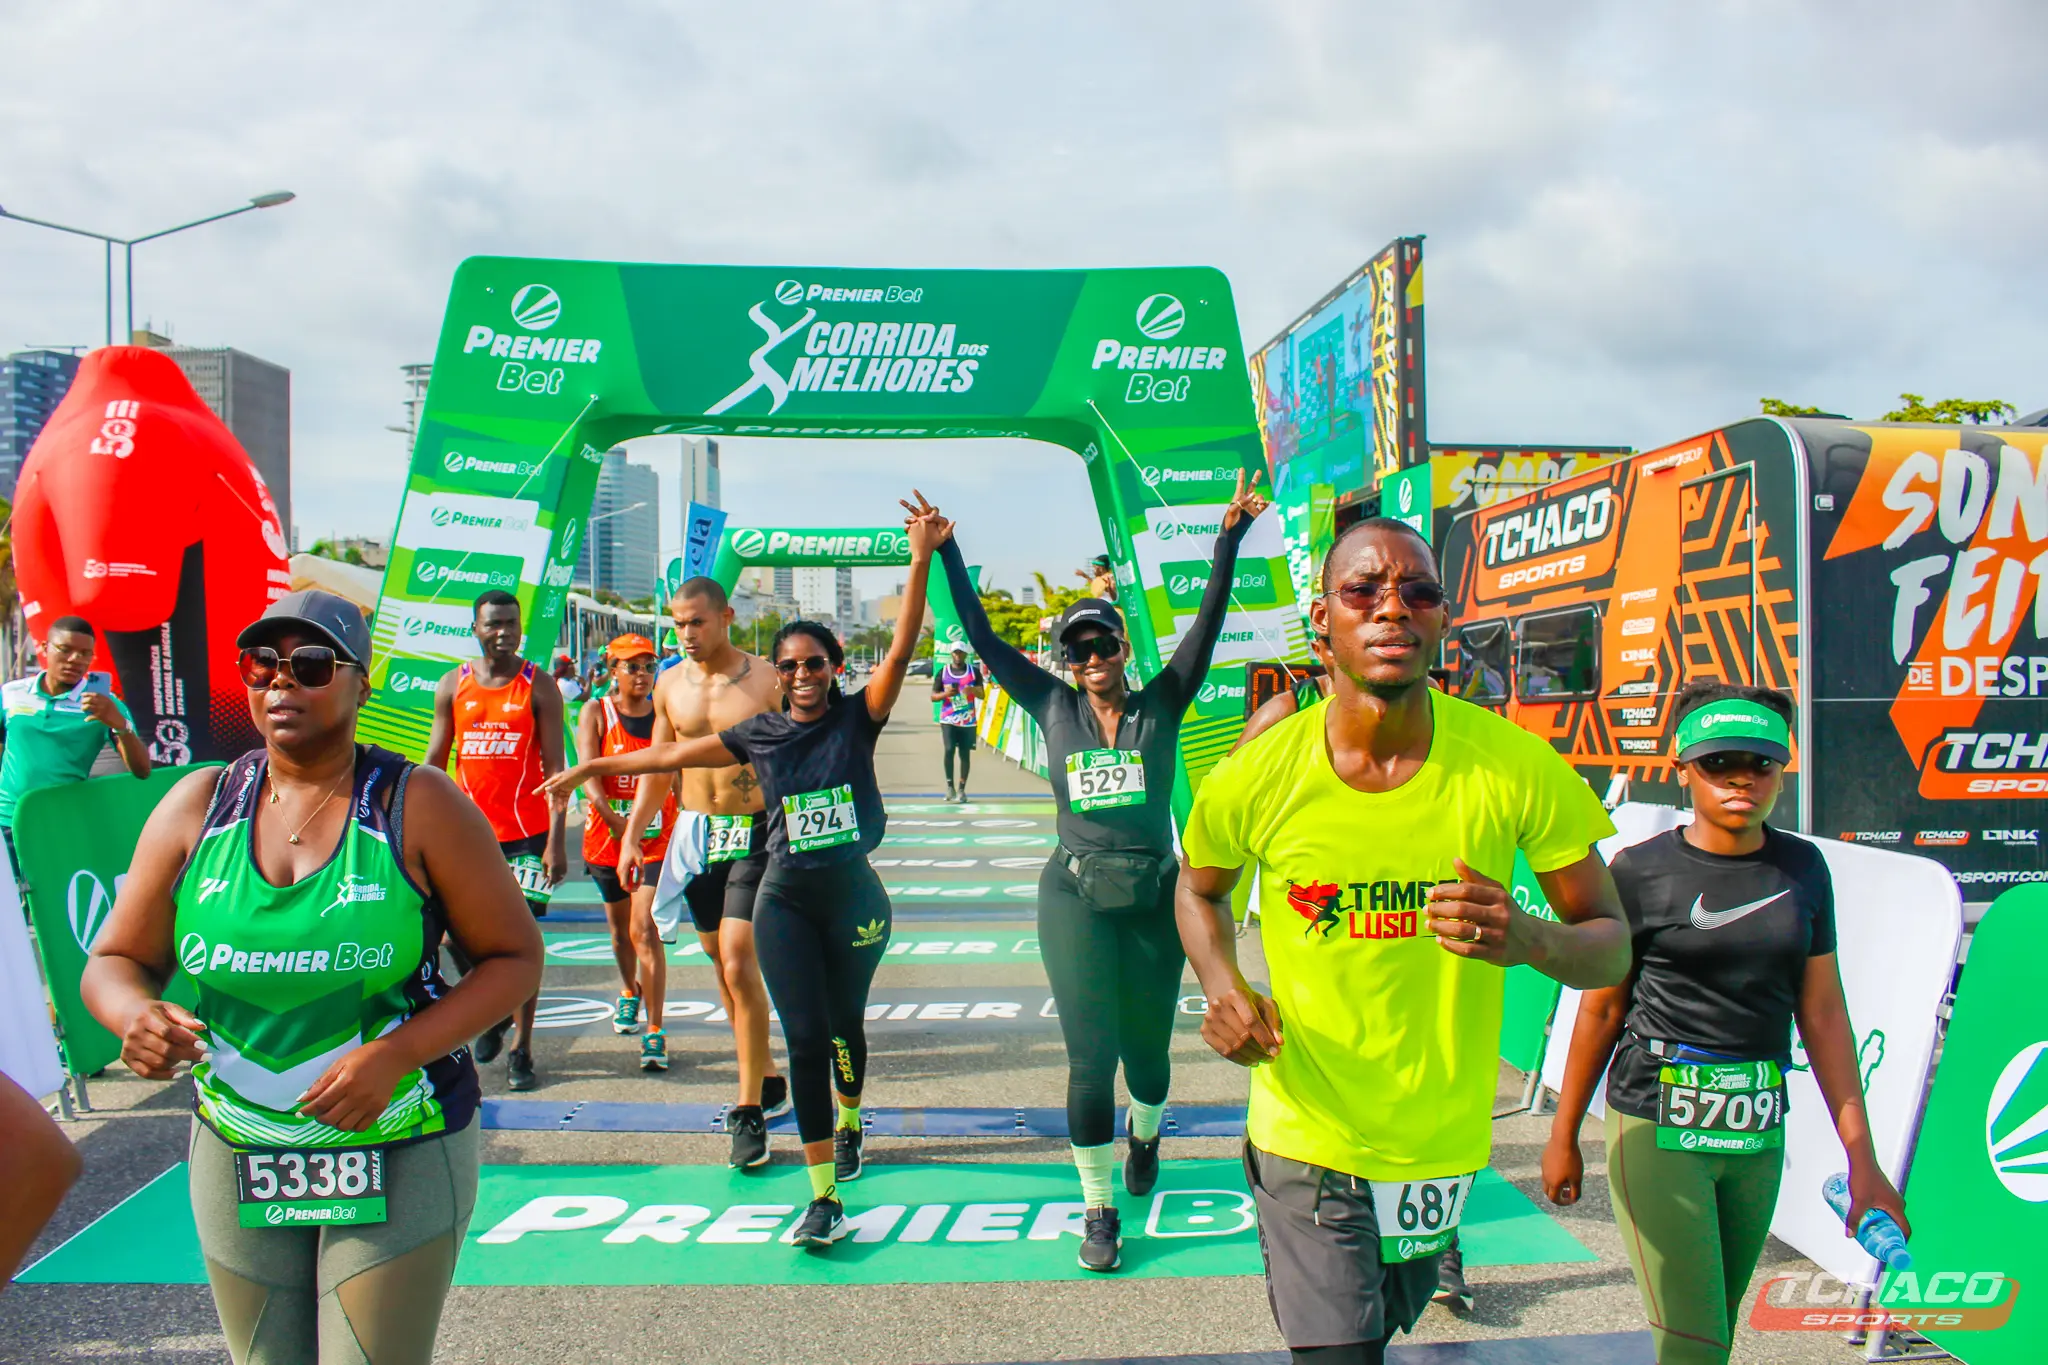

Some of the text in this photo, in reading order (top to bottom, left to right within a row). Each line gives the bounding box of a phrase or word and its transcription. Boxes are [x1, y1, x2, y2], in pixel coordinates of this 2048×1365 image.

[806, 284, 923, 302] PREMIER Bet
[464, 325, 601, 363] PREMIER
[805, 321, 989, 356] CORRIDA DOS
[1092, 339, 1227, 370] PREMIER
[496, 362, 564, 394] Bet
[788, 357, 979, 393] MELHORES
[1125, 373, 1191, 402] Bet
[1177, 523, 1222, 536] PREMIE
[1486, 487, 1612, 566] TCHACO
[767, 531, 912, 557] PREMIER Be
[489, 571, 515, 587] Bet
[1498, 554, 1587, 590] SPORTS
[1213, 631, 1254, 643] REMIER
[1908, 667, 1933, 685] DE
[461, 741, 517, 755] RUN
[1945, 733, 2048, 769] TCH
[1080, 767, 1127, 795] 529
[1967, 779, 2048, 793] SPO
[798, 808, 842, 836] 294
[1856, 831, 1901, 839] TCHACO
[1919, 830, 1967, 839] TCHACO
[1349, 911, 1417, 939] LUSO
[210, 942, 393, 973] PREMIER Bet
[1668, 1086, 1774, 1131] 5709
[248, 1151, 368, 1199] 5338
[372, 1151, 382, 1191] WALK
[332, 1206, 356, 1220] Bet
[1397, 1182, 1460, 1231] 681
